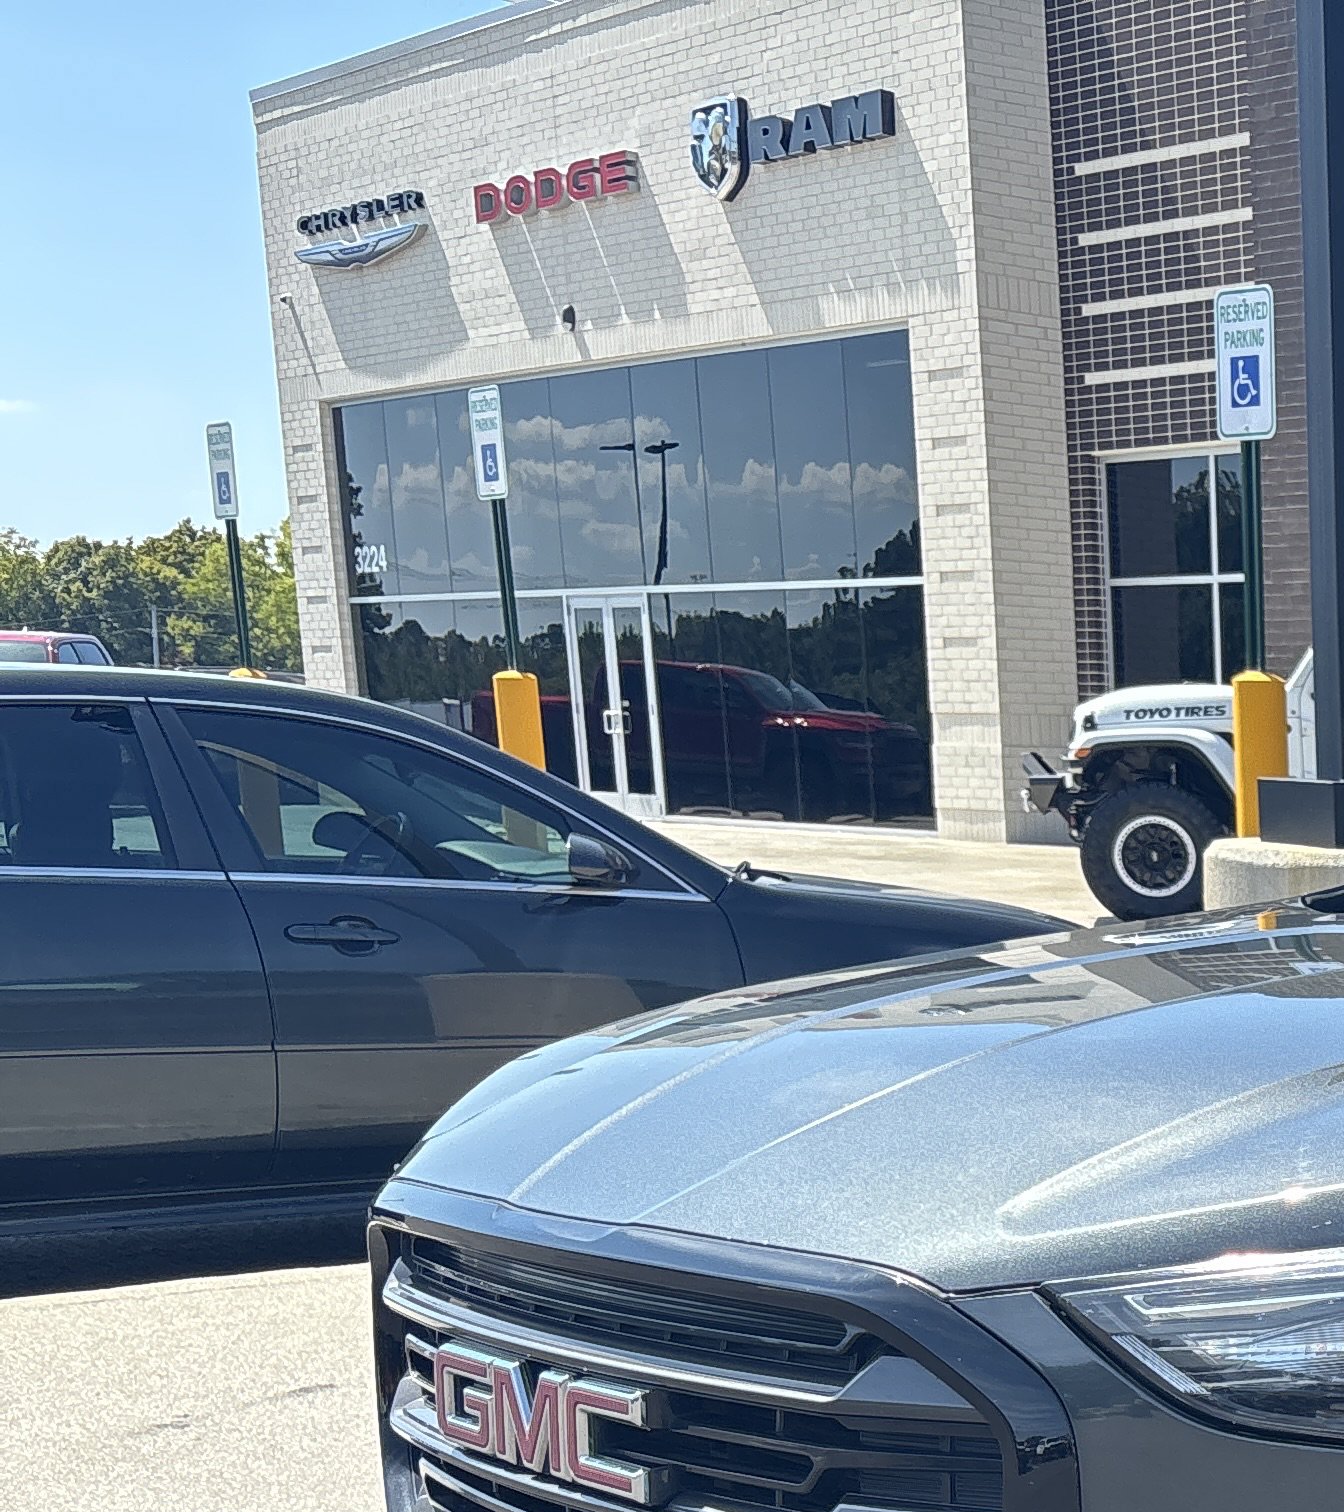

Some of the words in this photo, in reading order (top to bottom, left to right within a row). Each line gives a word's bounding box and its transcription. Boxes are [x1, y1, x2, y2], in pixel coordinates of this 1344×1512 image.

[749, 90, 895, 164] RAM
[473, 150, 640, 224] DODGE
[297, 189, 425, 235] CHRYSLER
[1219, 301, 1268, 324] RESERVED
[1223, 327, 1265, 349] PARKING
[354, 544, 387, 574] 3224
[1124, 707, 1173, 720] TOYO
[1175, 705, 1227, 717] TIRES
[433, 1340, 651, 1504] GMC
